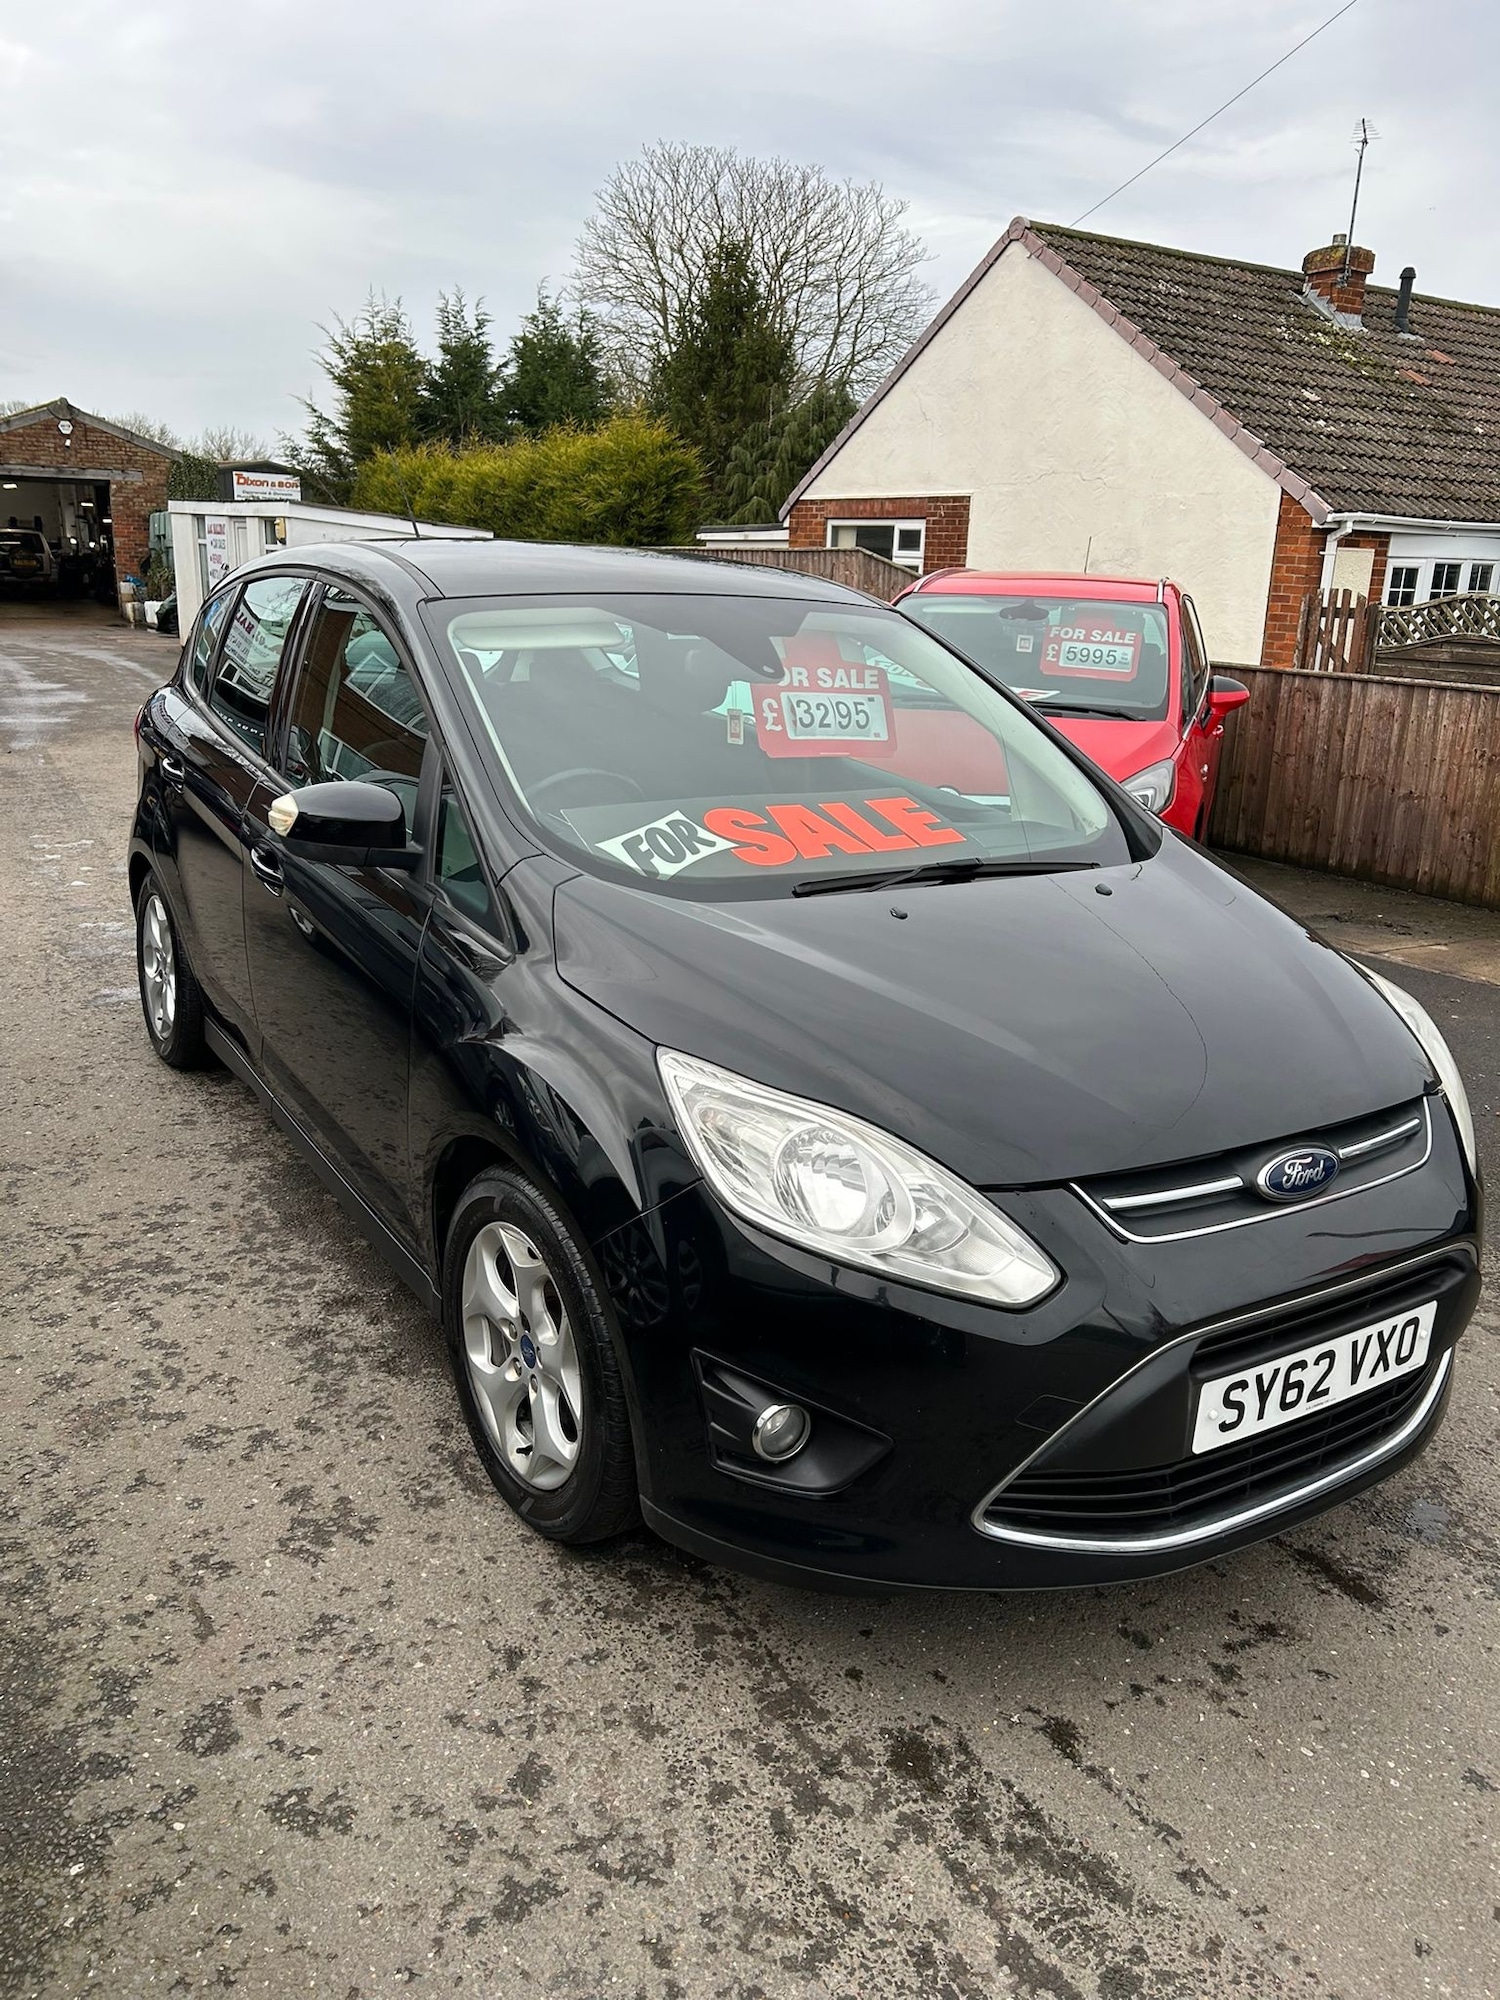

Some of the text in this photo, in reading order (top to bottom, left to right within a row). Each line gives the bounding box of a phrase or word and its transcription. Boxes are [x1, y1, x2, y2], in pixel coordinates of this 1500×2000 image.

[1049, 626, 1136, 644] FOR SALE
[1046, 643, 1118, 665] £ 5995
[816, 667, 880, 689] SALE
[762, 698, 870, 732] £ 3295
[621, 797, 967, 877] FOR SALE
[1282, 1156, 1326, 1190] Ford
[1218, 1316, 1421, 1433] SY62 VXO
